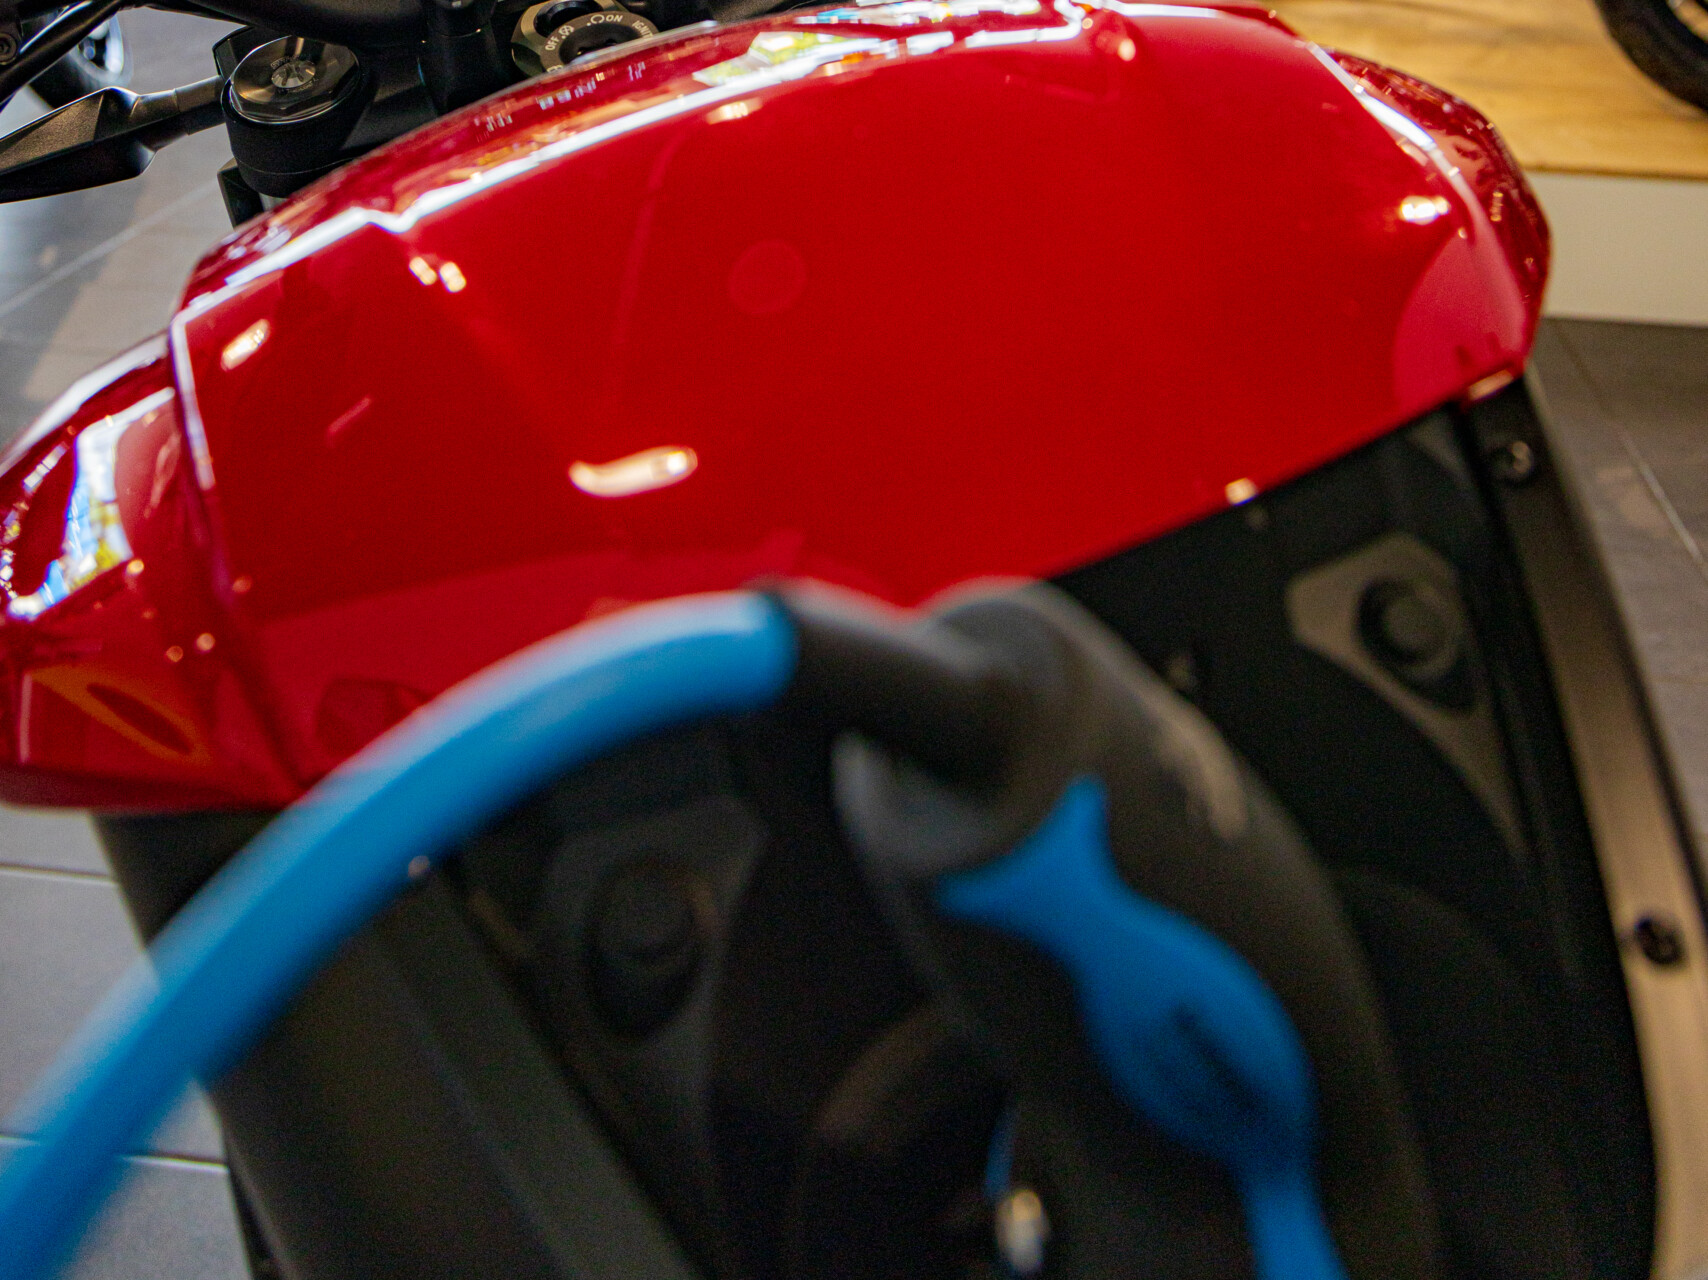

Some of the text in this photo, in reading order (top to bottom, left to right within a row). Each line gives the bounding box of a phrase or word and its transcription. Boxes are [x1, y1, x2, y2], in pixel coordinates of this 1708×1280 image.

[605, 14, 624, 23] ON
[632, 20, 655, 38] IGNIT
[545, 36, 560, 51] OFF
